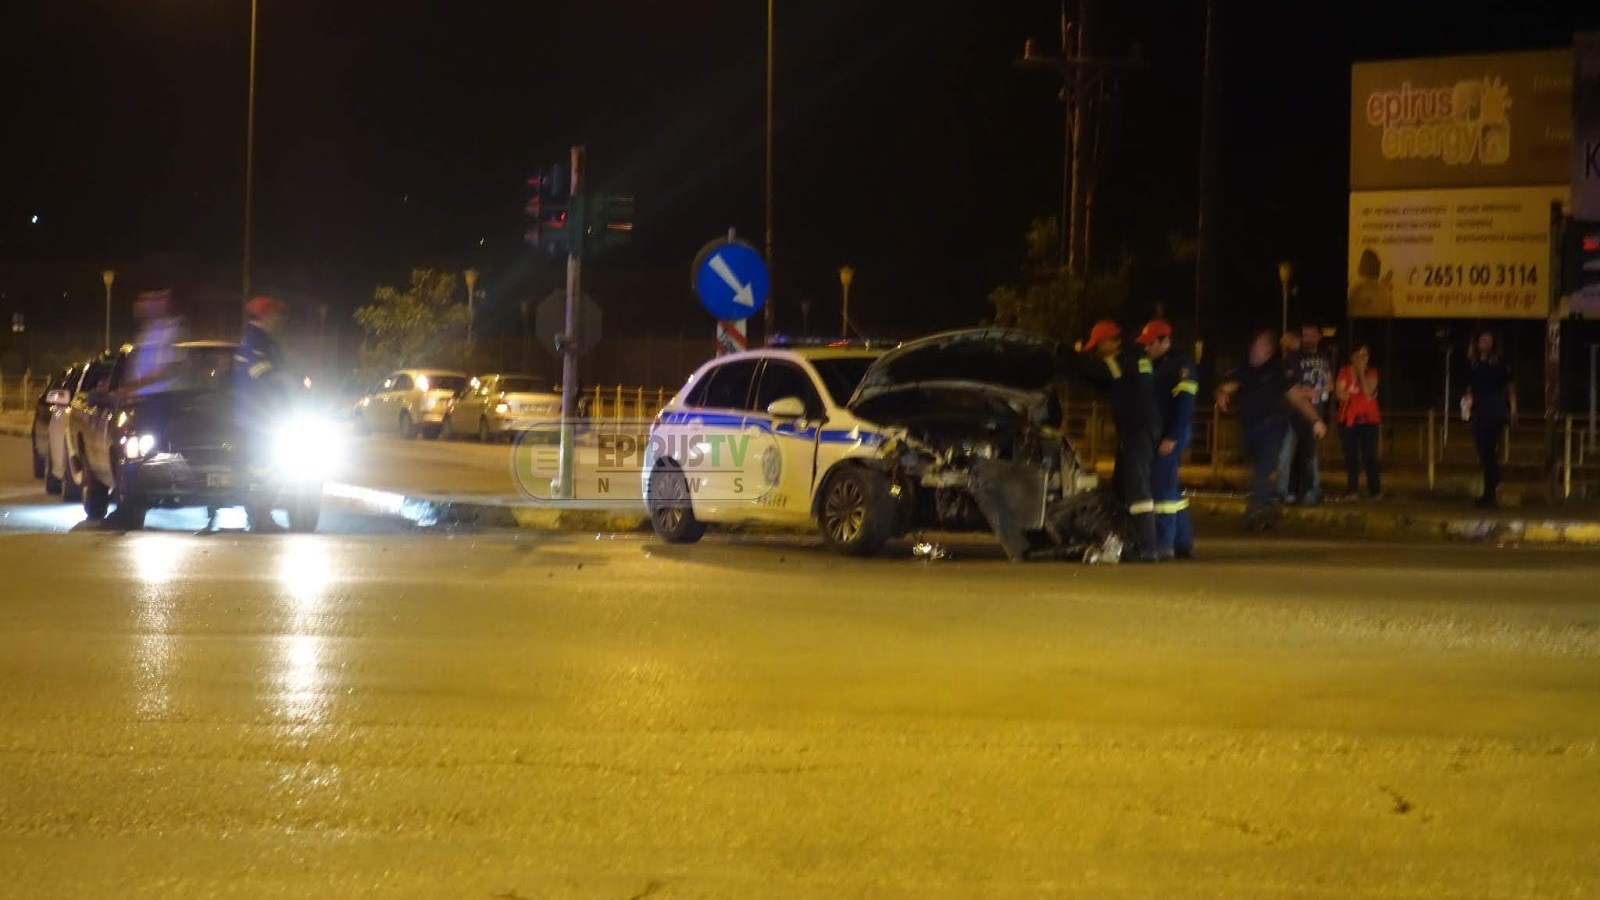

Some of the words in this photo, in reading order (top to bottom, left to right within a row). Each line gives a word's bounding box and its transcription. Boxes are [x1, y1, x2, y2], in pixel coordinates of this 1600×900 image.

[1367, 82, 1453, 127] epirus
[1382, 124, 1479, 164] energy
[1423, 264, 1463, 286] 2651
[1469, 264, 1491, 286] 00
[1496, 262, 1538, 286] 3114
